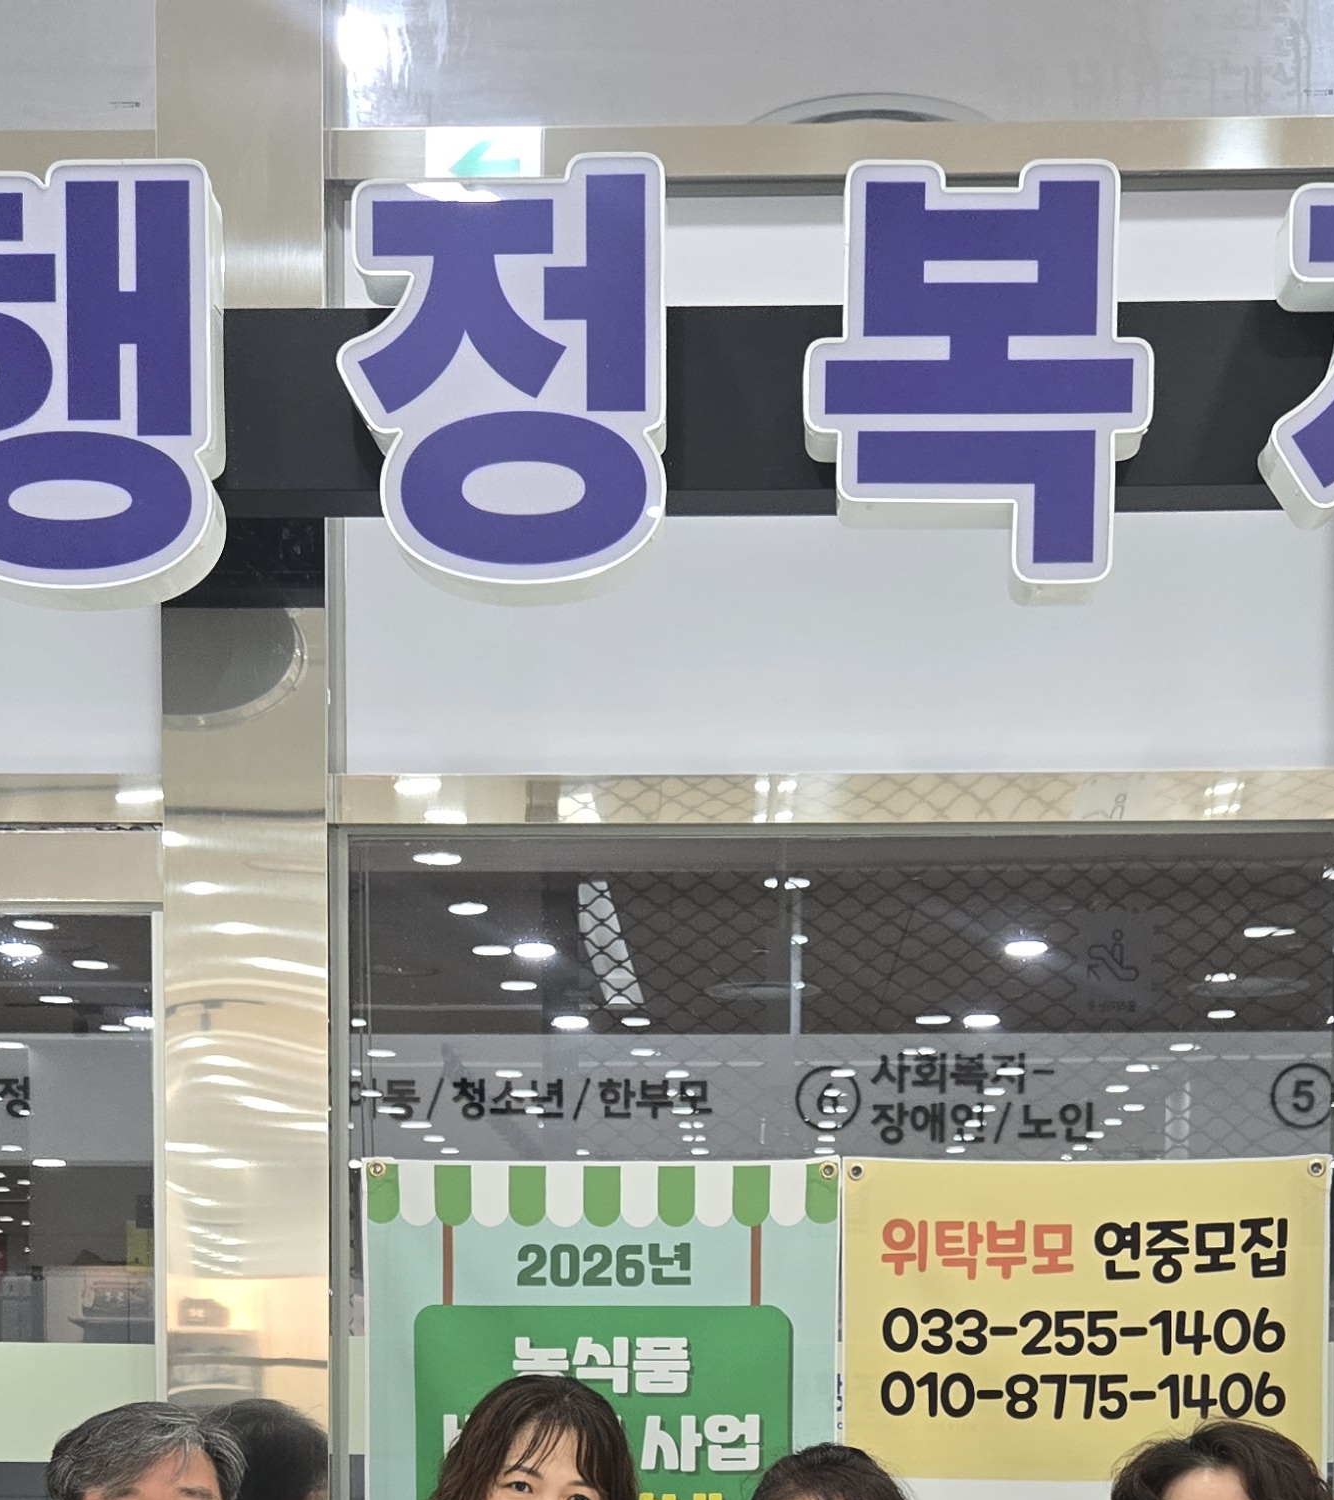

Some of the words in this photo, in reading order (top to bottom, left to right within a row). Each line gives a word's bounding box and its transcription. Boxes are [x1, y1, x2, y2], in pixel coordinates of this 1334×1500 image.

[516, 1242, 692, 1287] 2026년
[881, 1218, 1074, 1280] 위탁부모
[1094, 1217, 1289, 1283] 연중모집
[882, 1307, 1287, 1356] 033-255-1406
[513, 1336, 691, 1395] 농식품
[880, 1370, 1287, 1420] 010-8775-1406
[640, 1413, 762, 1473] 사업
